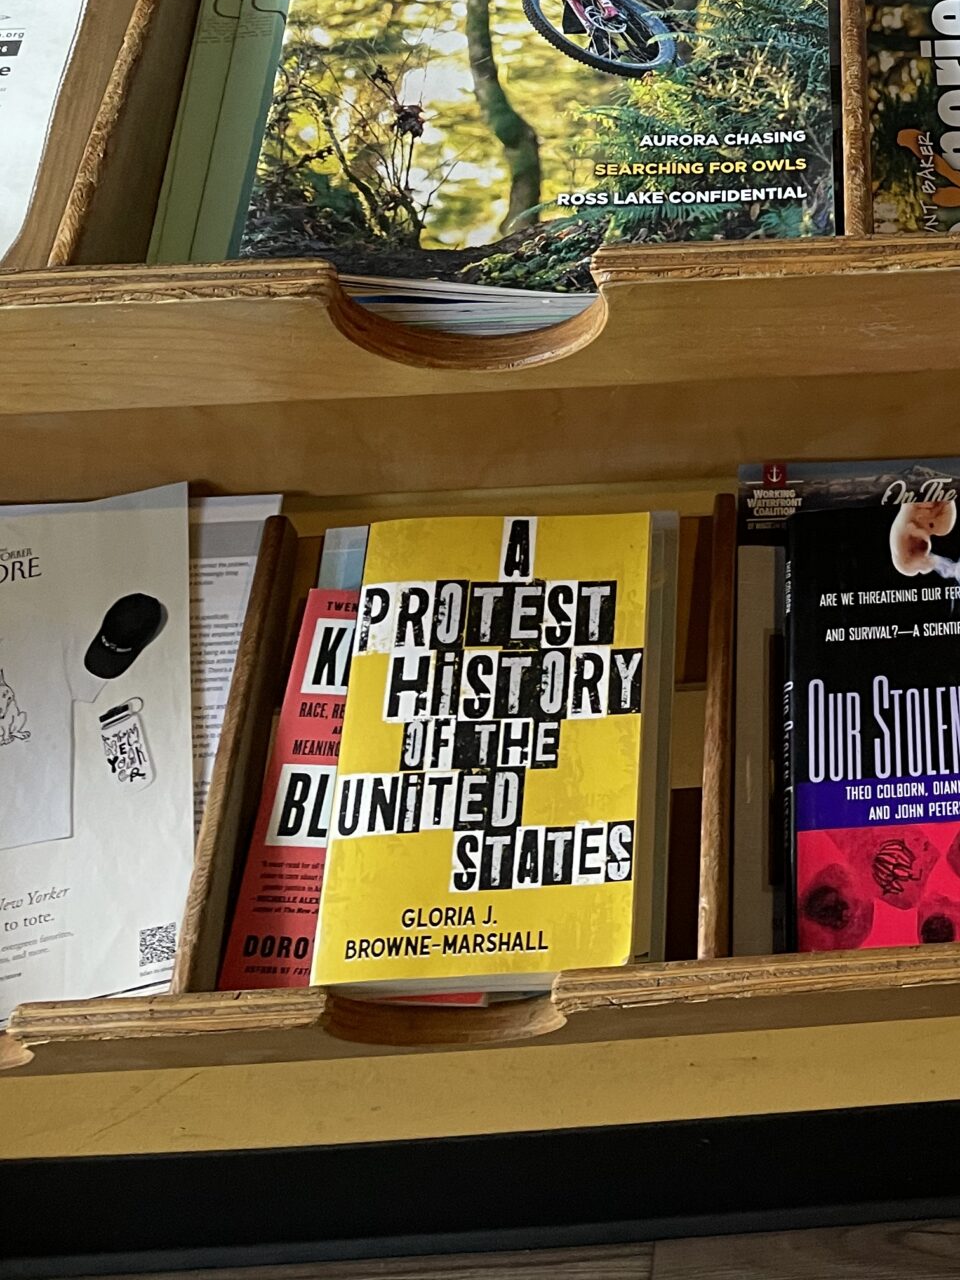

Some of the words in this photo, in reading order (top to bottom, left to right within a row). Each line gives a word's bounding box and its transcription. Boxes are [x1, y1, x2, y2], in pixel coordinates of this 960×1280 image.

[640, 134, 719, 147] AURORA
[724, 130, 806, 146] CHASING
[595, 162, 703, 176] SEARCHING
[710, 161, 747, 173] FOR
[752, 158, 806, 171] OWLS
[557, 193, 608, 206] ROSS
[614, 191, 664, 205] LAKE
[668, 185, 807, 203] CONFIDENTIAL
[747, 498, 803, 508] WATERFRONT
[753, 489, 796, 499] WORKING
[753, 507, 796, 516] COALITION
[505, 519, 530, 577] A
[820, 591, 838, 607] ARE
[840, 590, 856, 605] WE
[858, 587, 918, 605] THREATENING
[921, 586, 941, 601] OUR
[358, 582, 612, 652] PROTEST
[825, 627, 845, 641] AND
[808, 678, 861, 783] OUR
[404, 722, 452, 768] OF
[477, 721, 559, 766] THE
[846, 785, 872, 801] THEO
[869, 805, 890, 821] AND
[895, 803, 925, 819] JOHN
[453, 822, 632, 890] STATES
[27, 887, 70, 906] Yorker
[4, 920, 19, 931] to
[23, 914, 55, 928] tote.
[402, 907, 476, 928] GLORIA
[483, 906, 498, 926] J.
[345, 930, 548, 961] BROWNE-MARSHALL
